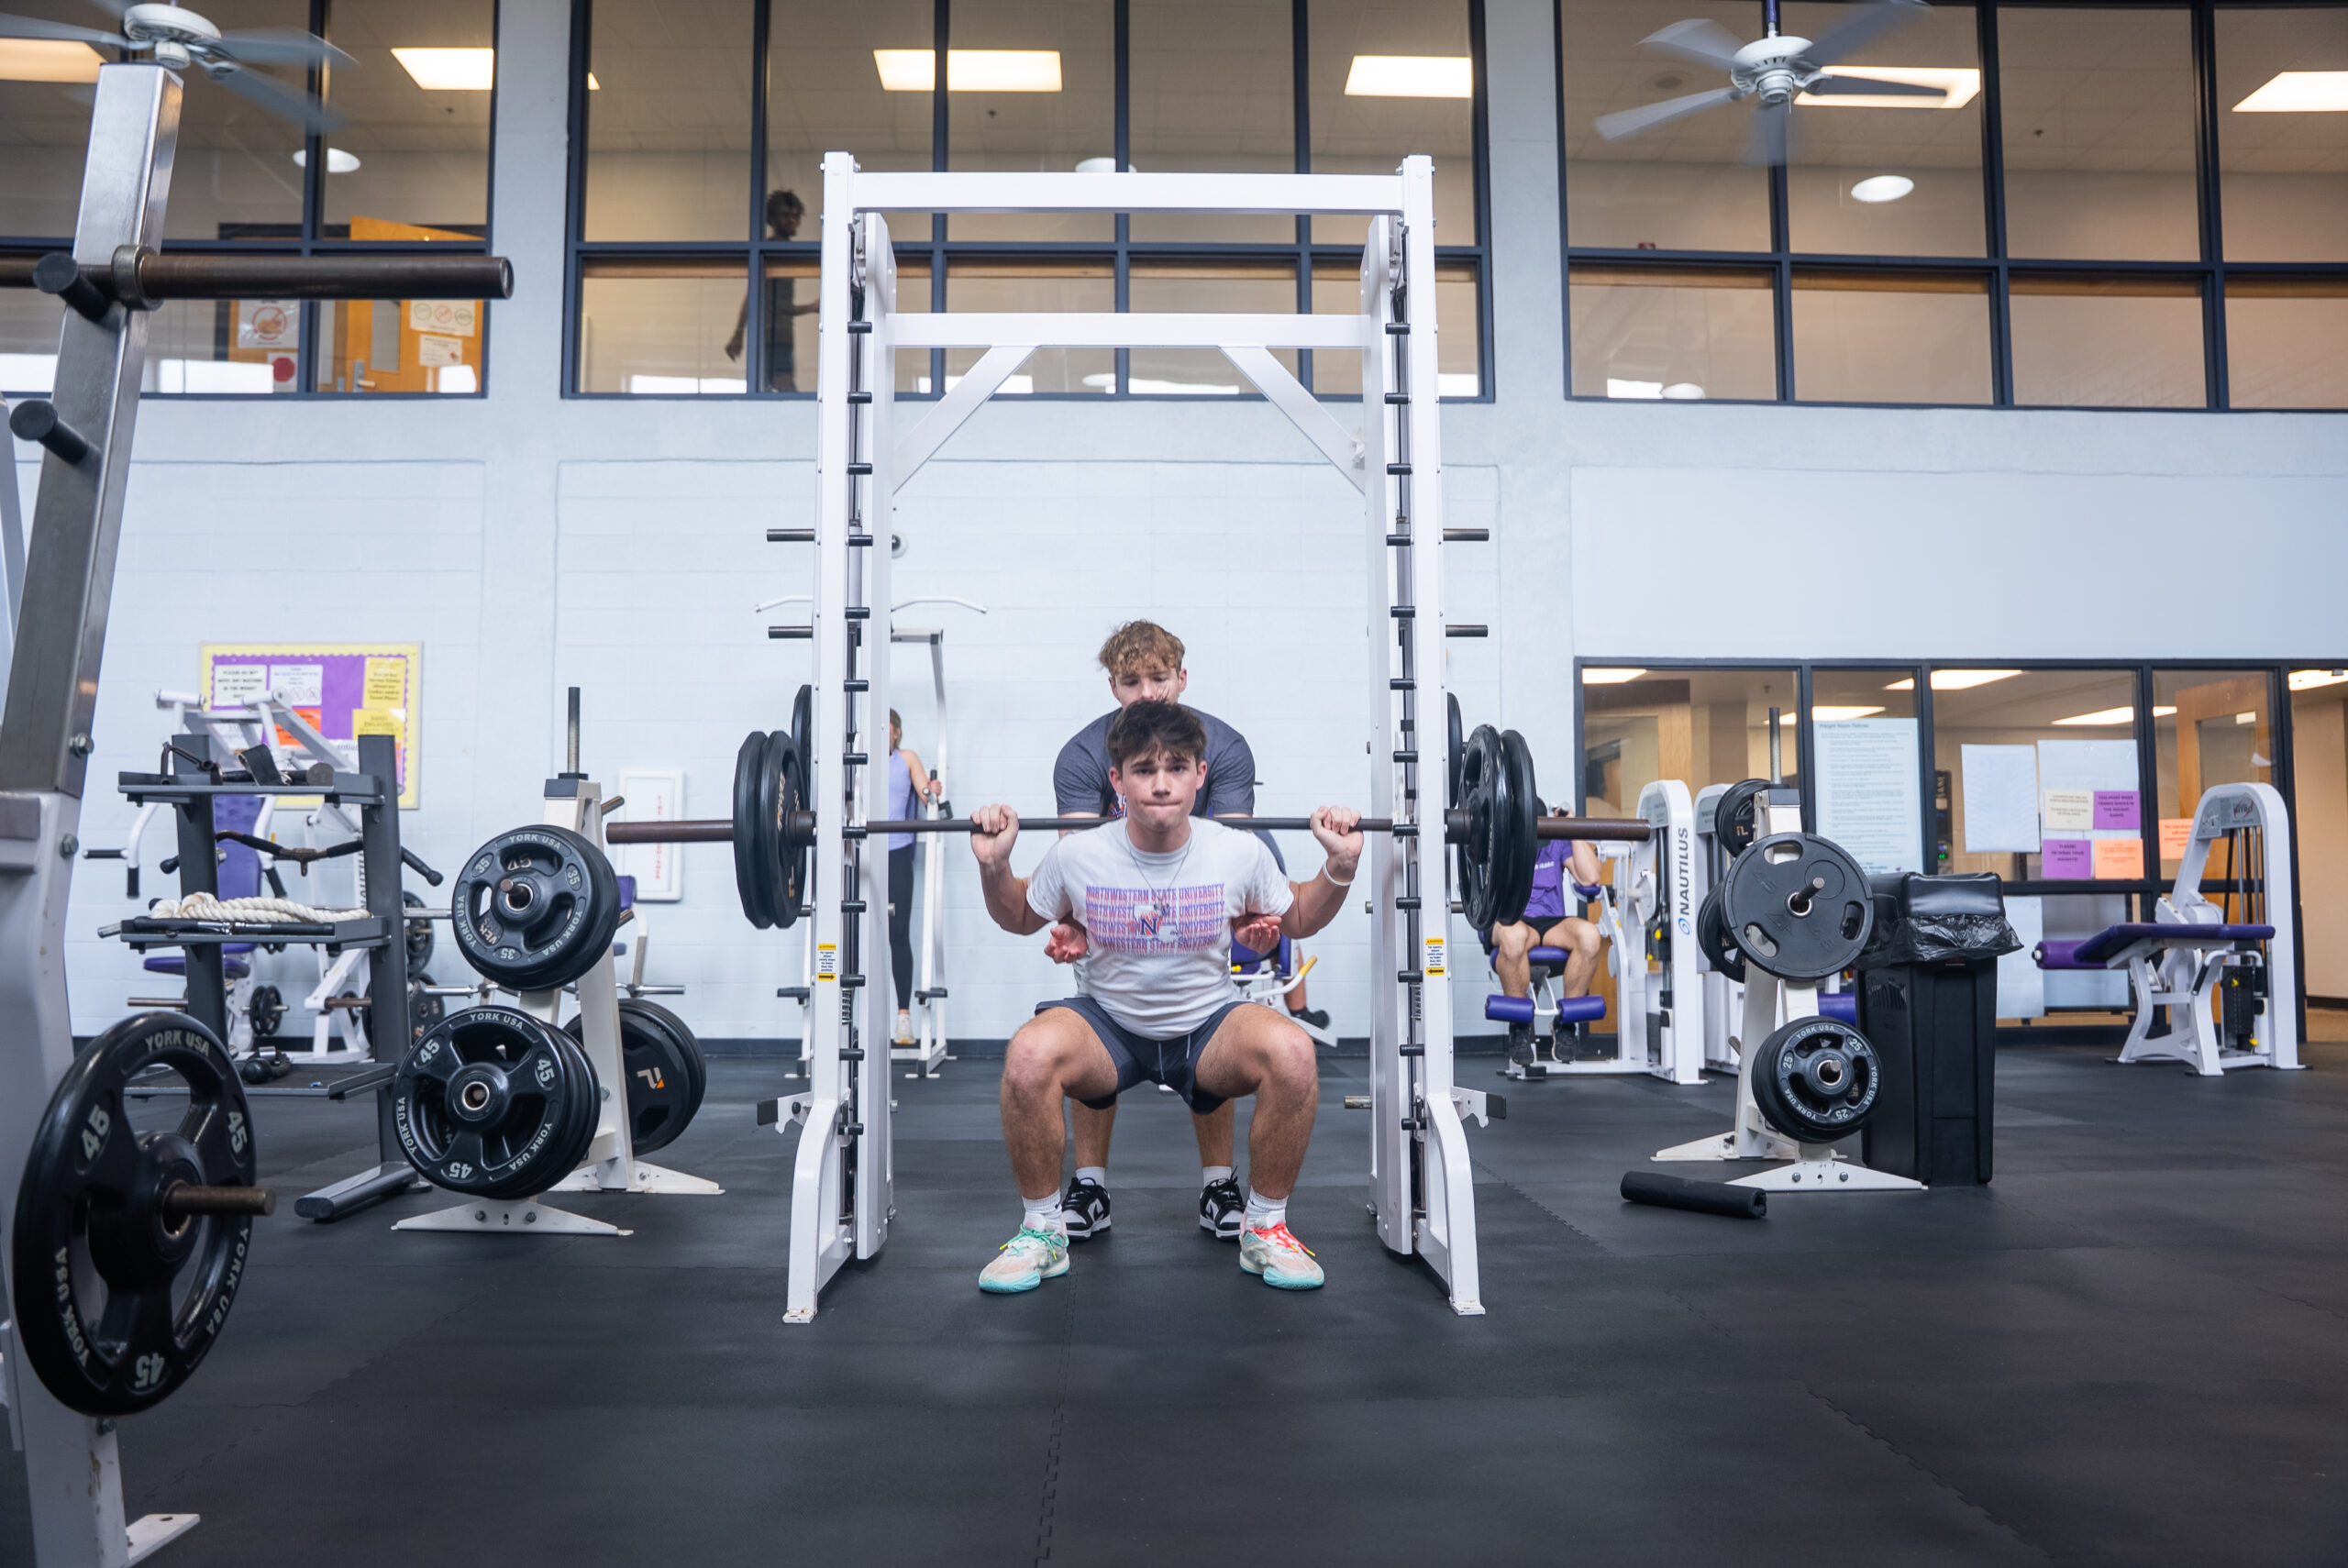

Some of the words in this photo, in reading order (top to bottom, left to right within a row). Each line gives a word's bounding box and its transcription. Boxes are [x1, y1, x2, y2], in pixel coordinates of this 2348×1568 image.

[509, 833, 539, 844] YORK
[541, 835, 562, 850] USA
[474, 856, 491, 874] 35
[1678, 827, 1690, 916] NAUTILUS
[567, 868, 581, 886] 35
[1086, 885, 1149, 902] NORTHWESTERN
[1151, 888, 1177, 901] STATE
[1179, 883, 1224, 900] UNIVERSITY
[458, 895, 466, 918] USA
[1179, 901, 1224, 919] UNIVERSITY
[460, 921, 477, 948] YORK
[564, 911, 583, 940] YORK
[1139, 918, 1158, 935] N
[500, 947, 516, 960] 35
[542, 939, 564, 956] USA
[470, 1012, 501, 1023] YORK
[503, 1014, 524, 1030] USA
[1796, 1027, 1817, 1039] YORK
[145, 1029, 183, 1053] YORK
[185, 1029, 210, 1057] USA
[418, 1038, 440, 1064] 45
[1849, 1038, 1863, 1052] 25
[537, 1058, 555, 1083] 45
[1783, 1055, 1793, 1069] 25
[1785, 1088, 1796, 1105] USA
[1864, 1090, 1876, 1106] USA
[397, 1097, 406, 1119] USA
[1796, 1104, 1816, 1121] YORK
[1835, 1109, 1849, 1120] 25
[82, 1104, 110, 1159] 45
[227, 1110, 248, 1154] 45
[399, 1121, 418, 1154] YORK
[529, 1122, 553, 1154] YORK
[449, 1162, 473, 1179] 45
[509, 1153, 531, 1171] USA
[226, 1227, 249, 1288] YORK
[55, 1246, 69, 1302] USA
[205, 1288, 230, 1336] USA
[61, 1305, 90, 1367] YORK
[135, 1354, 165, 1388] 45
